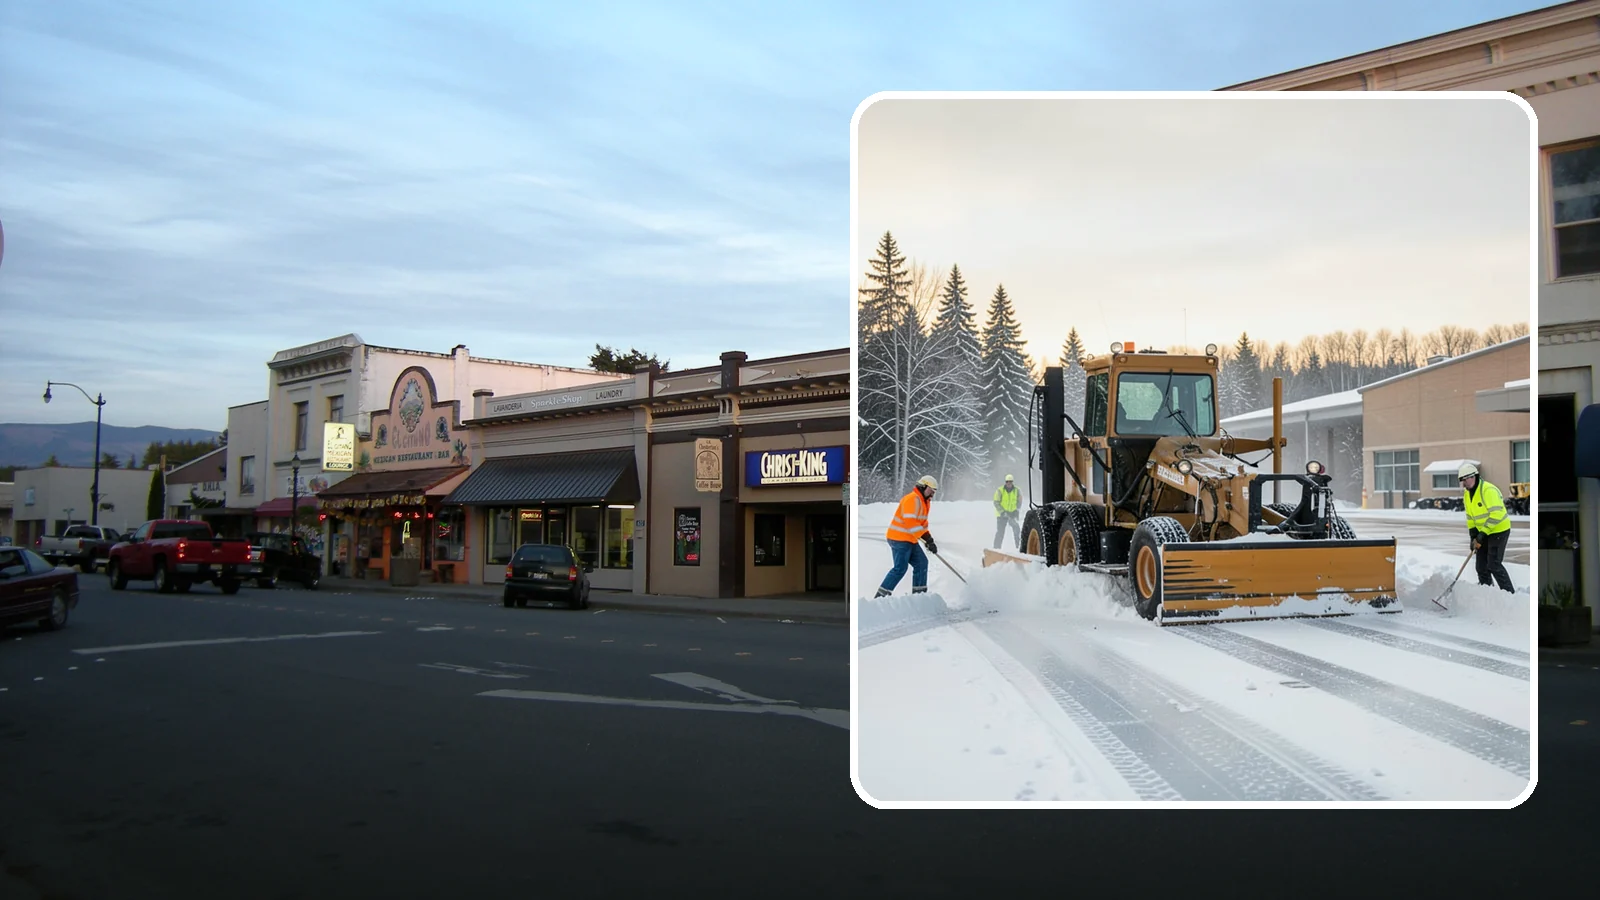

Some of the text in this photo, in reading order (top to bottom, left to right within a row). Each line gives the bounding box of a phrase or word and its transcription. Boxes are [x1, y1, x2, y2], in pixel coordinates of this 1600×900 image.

[595, 389, 623, 399] LAUNDRY
[493, 402, 522, 412] LAVANDERIA
[373, 456, 396, 464] MEXICAN
[397, 452, 433, 462] RESTAURANT
[438, 450, 449, 459] BAR
